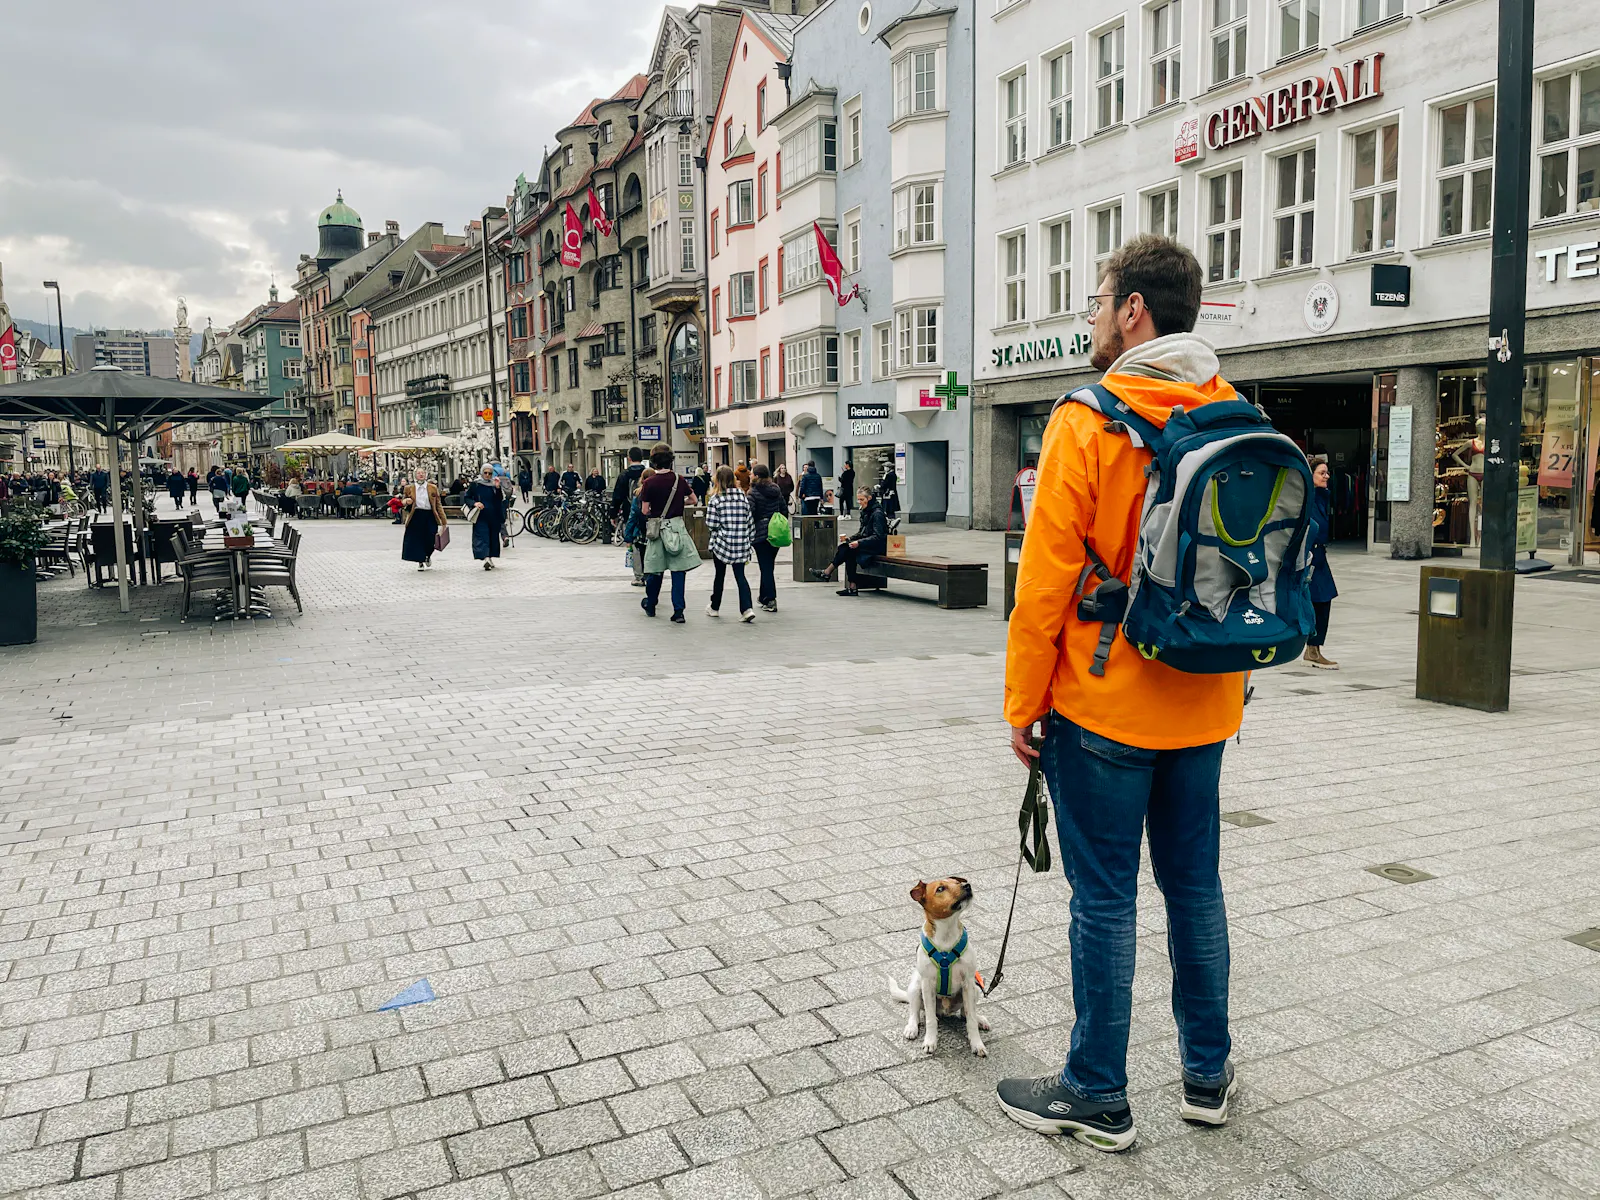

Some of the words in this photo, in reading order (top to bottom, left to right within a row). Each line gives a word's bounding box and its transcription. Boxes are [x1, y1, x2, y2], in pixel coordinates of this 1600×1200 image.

[1203, 52, 1384, 151] GENERALI
[1175, 144, 1197, 157] GENERALI
[1535, 241, 1600, 282] TE
[1200, 313, 1232, 321] NOTARIAT
[1014, 337, 1063, 363] ANNA
[1069, 332, 1093, 355] AP
